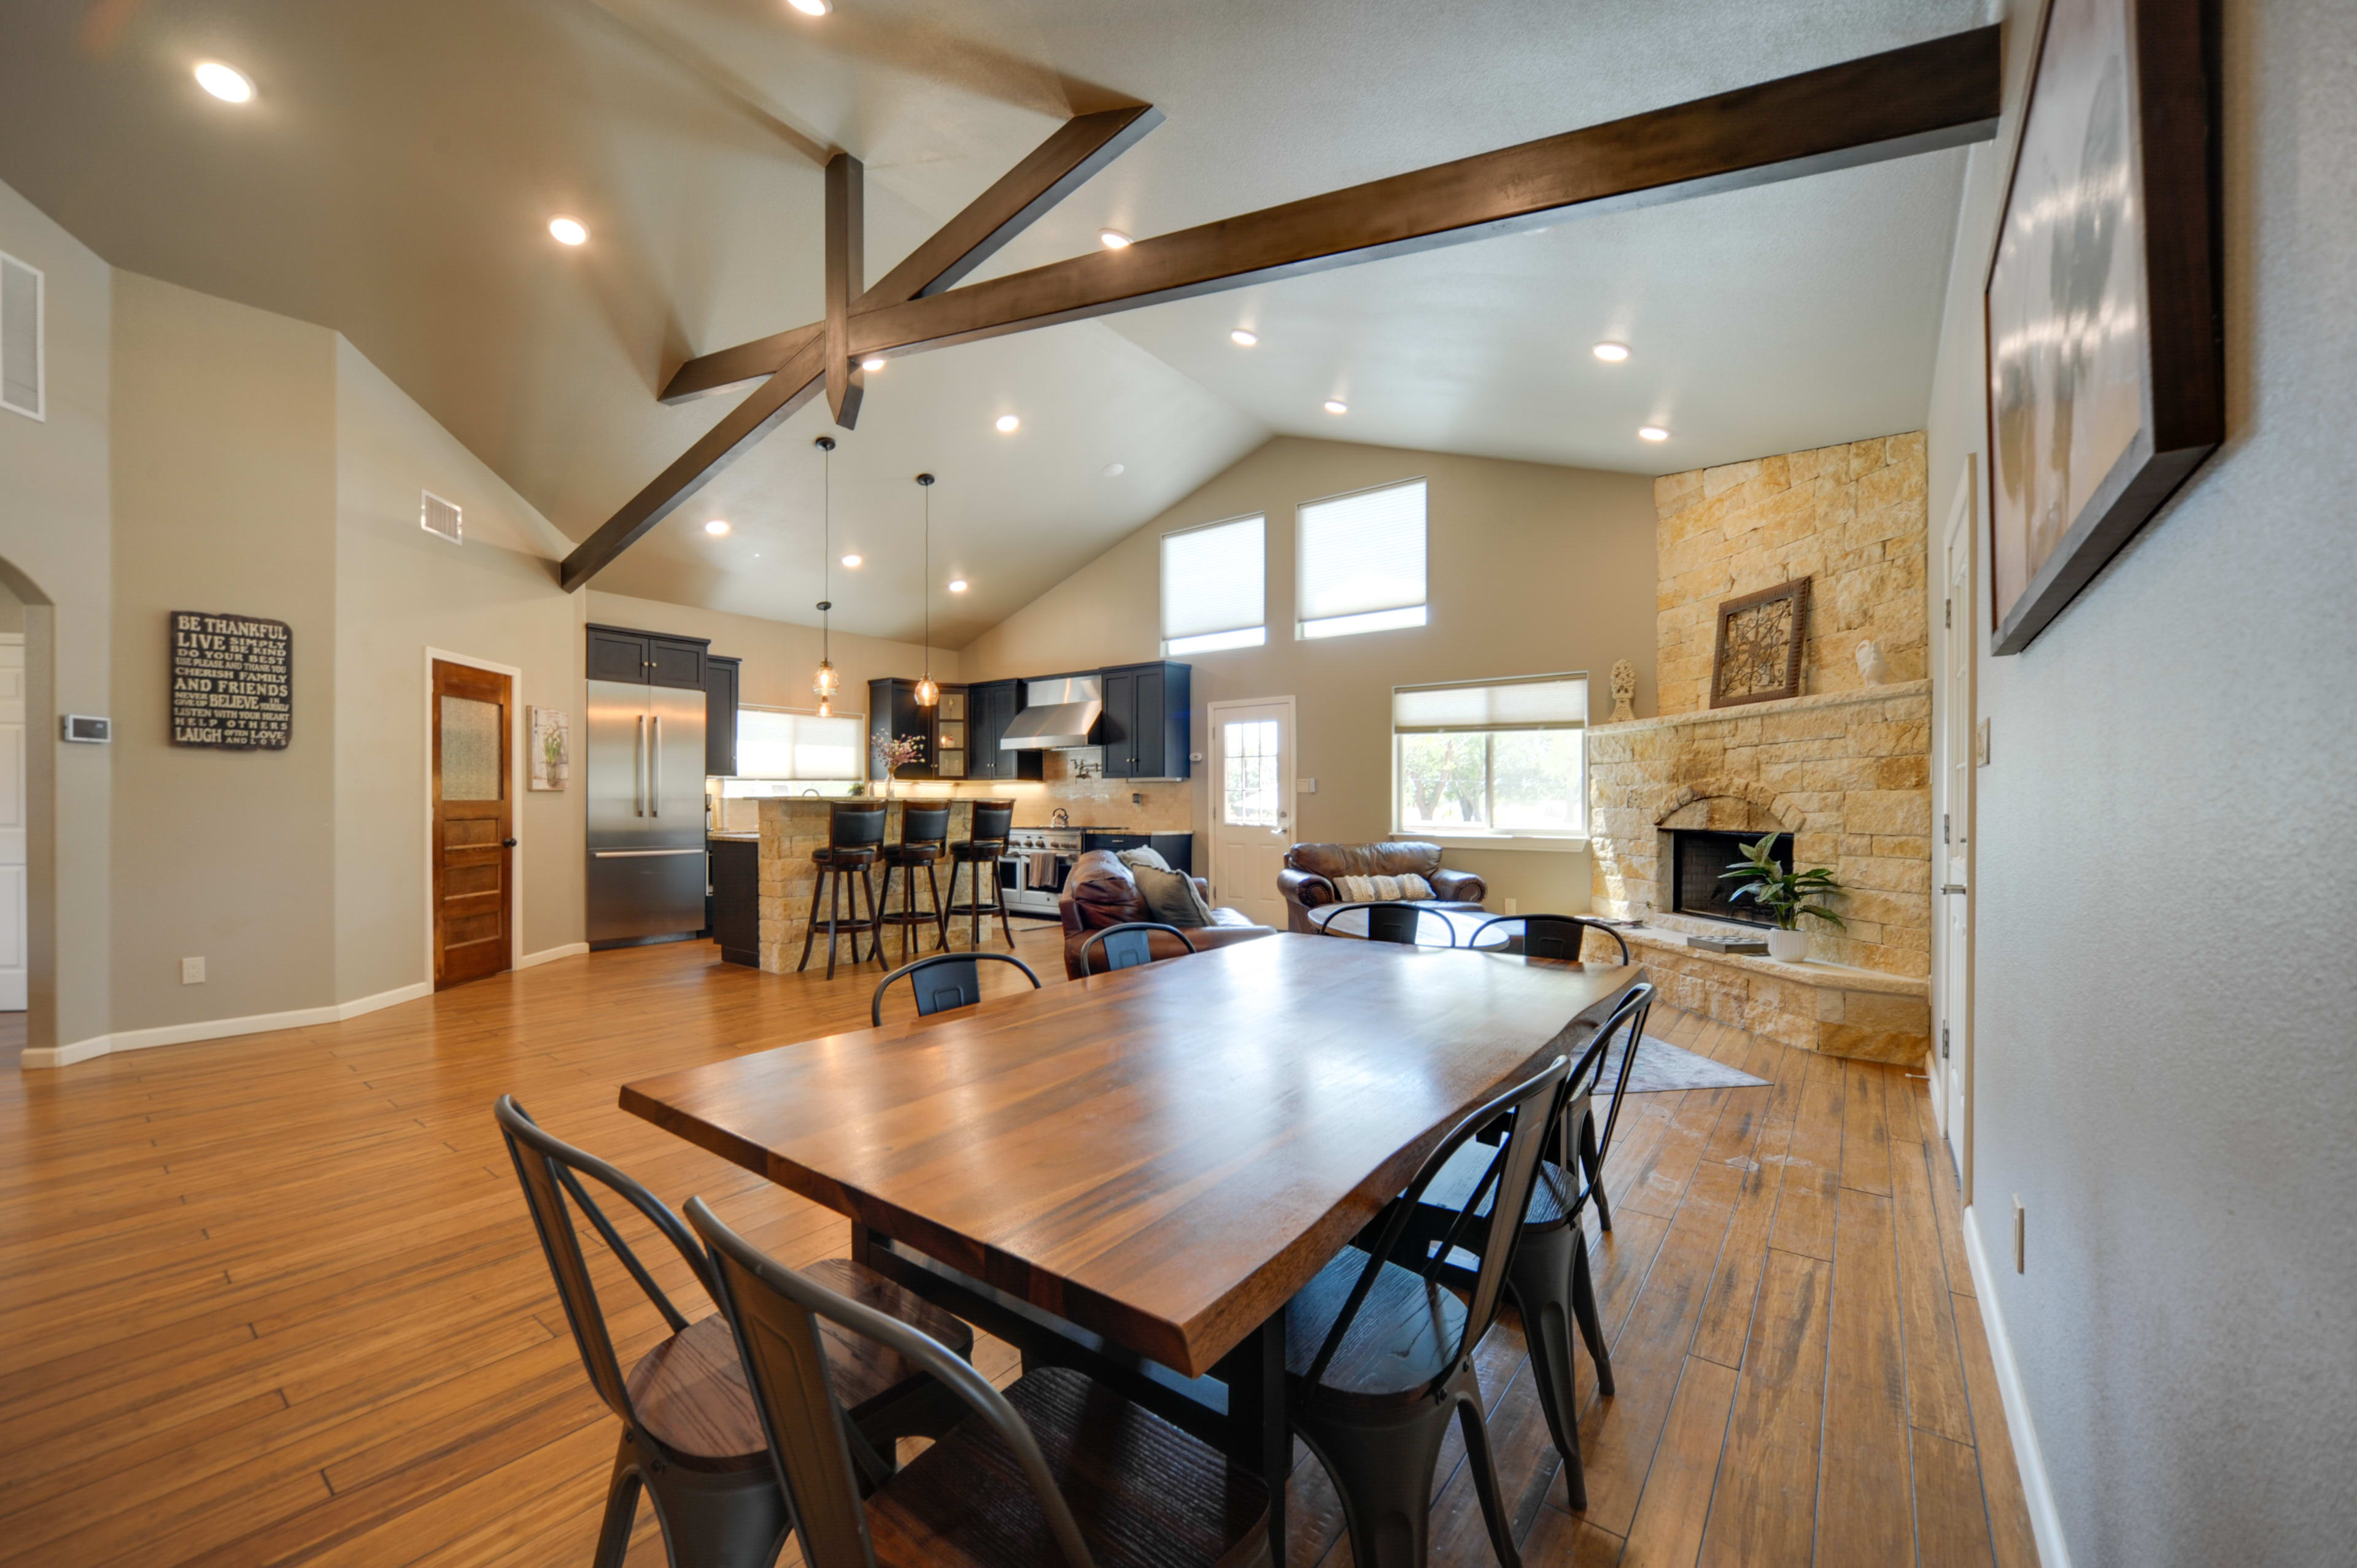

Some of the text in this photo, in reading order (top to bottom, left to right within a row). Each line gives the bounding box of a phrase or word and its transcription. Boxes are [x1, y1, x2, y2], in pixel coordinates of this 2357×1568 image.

[178, 616, 287, 639] BE THANKFUL
[177, 633, 225, 650] LIVE
[229, 638, 285, 649] SIMPLY
[205, 651, 244, 661] YOUR
[249, 655, 285, 665] BEST
[253, 646, 286, 657] KIND
[193, 658, 224, 668] PLEASE
[225, 662, 242, 670] AND
[243, 663, 270, 672] THANK
[175, 667, 287, 683] CHERISH FAMILY
[175, 678, 288, 697] AND FRIENDS
[209, 694, 258, 710] BELIEVE
[174, 708, 289, 721] LISTEN WITH YOUR HEART
[175, 717, 288, 730] HELP OTHERS
[175, 727, 222, 743] LAUGH
[250, 730, 285, 739] LOVE
